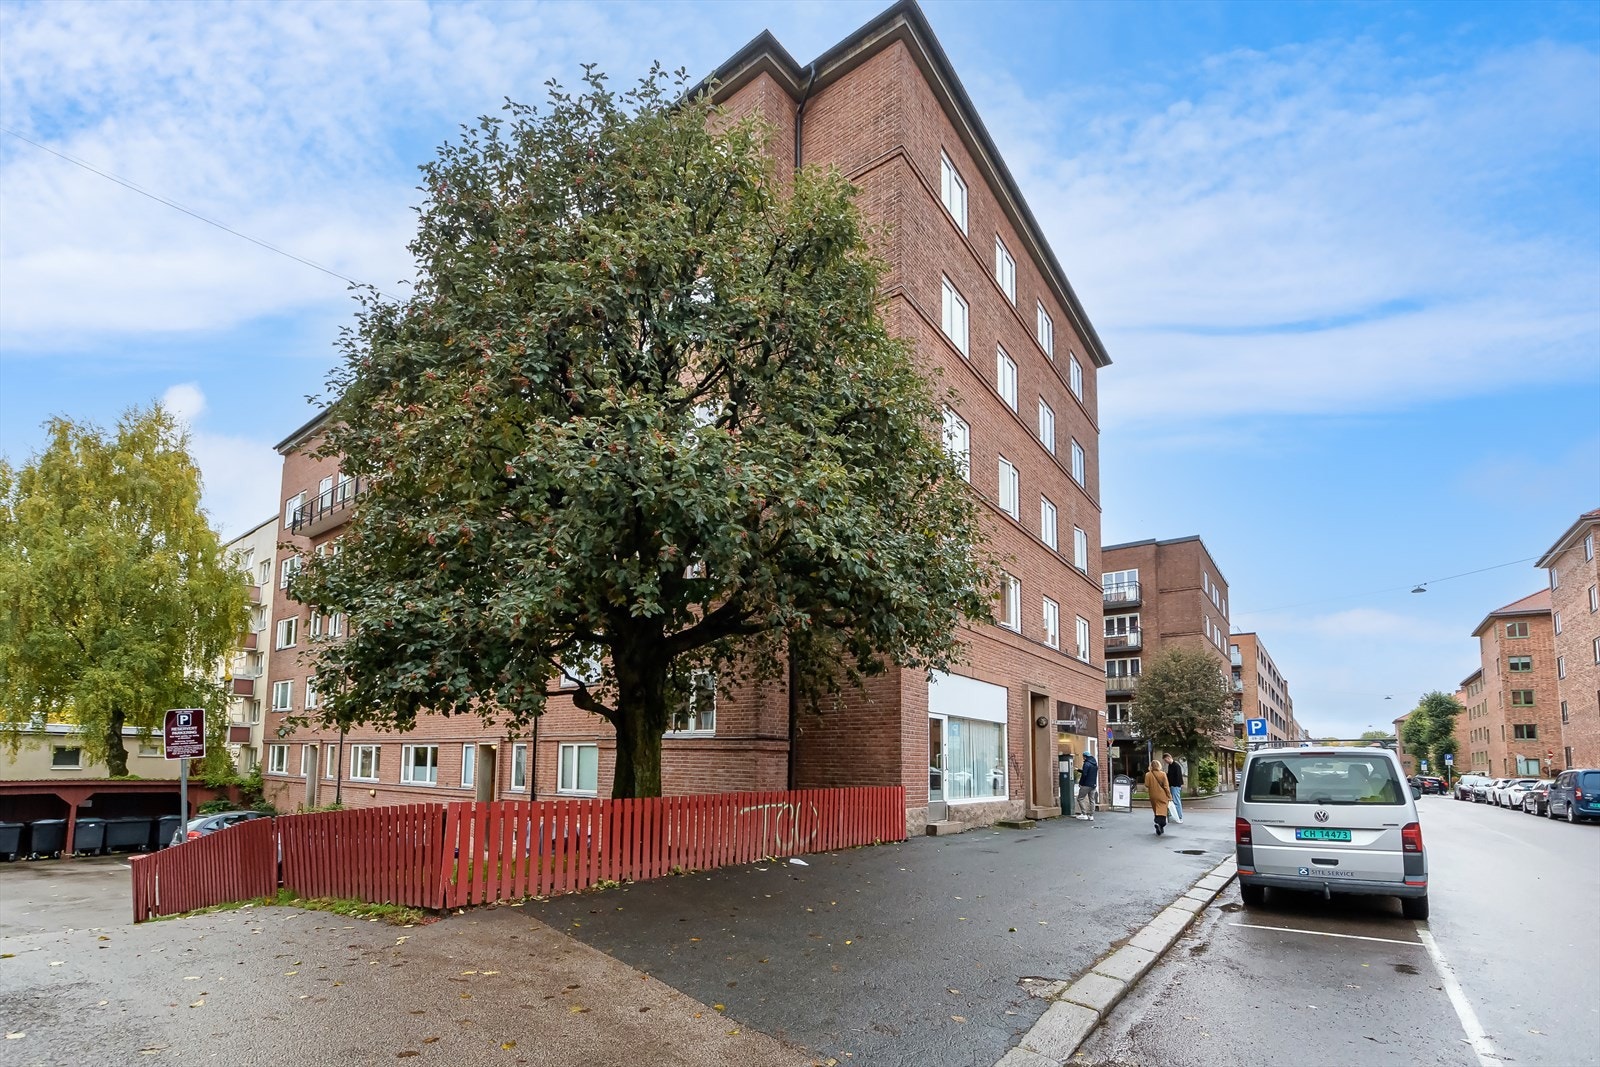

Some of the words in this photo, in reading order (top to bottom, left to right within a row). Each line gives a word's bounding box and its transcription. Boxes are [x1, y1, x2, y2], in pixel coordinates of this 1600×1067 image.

[179, 715, 189, 724] P
[1251, 720, 1262, 734] P
[1303, 830, 1316, 838] CH
[1319, 830, 1348, 839] 14473
